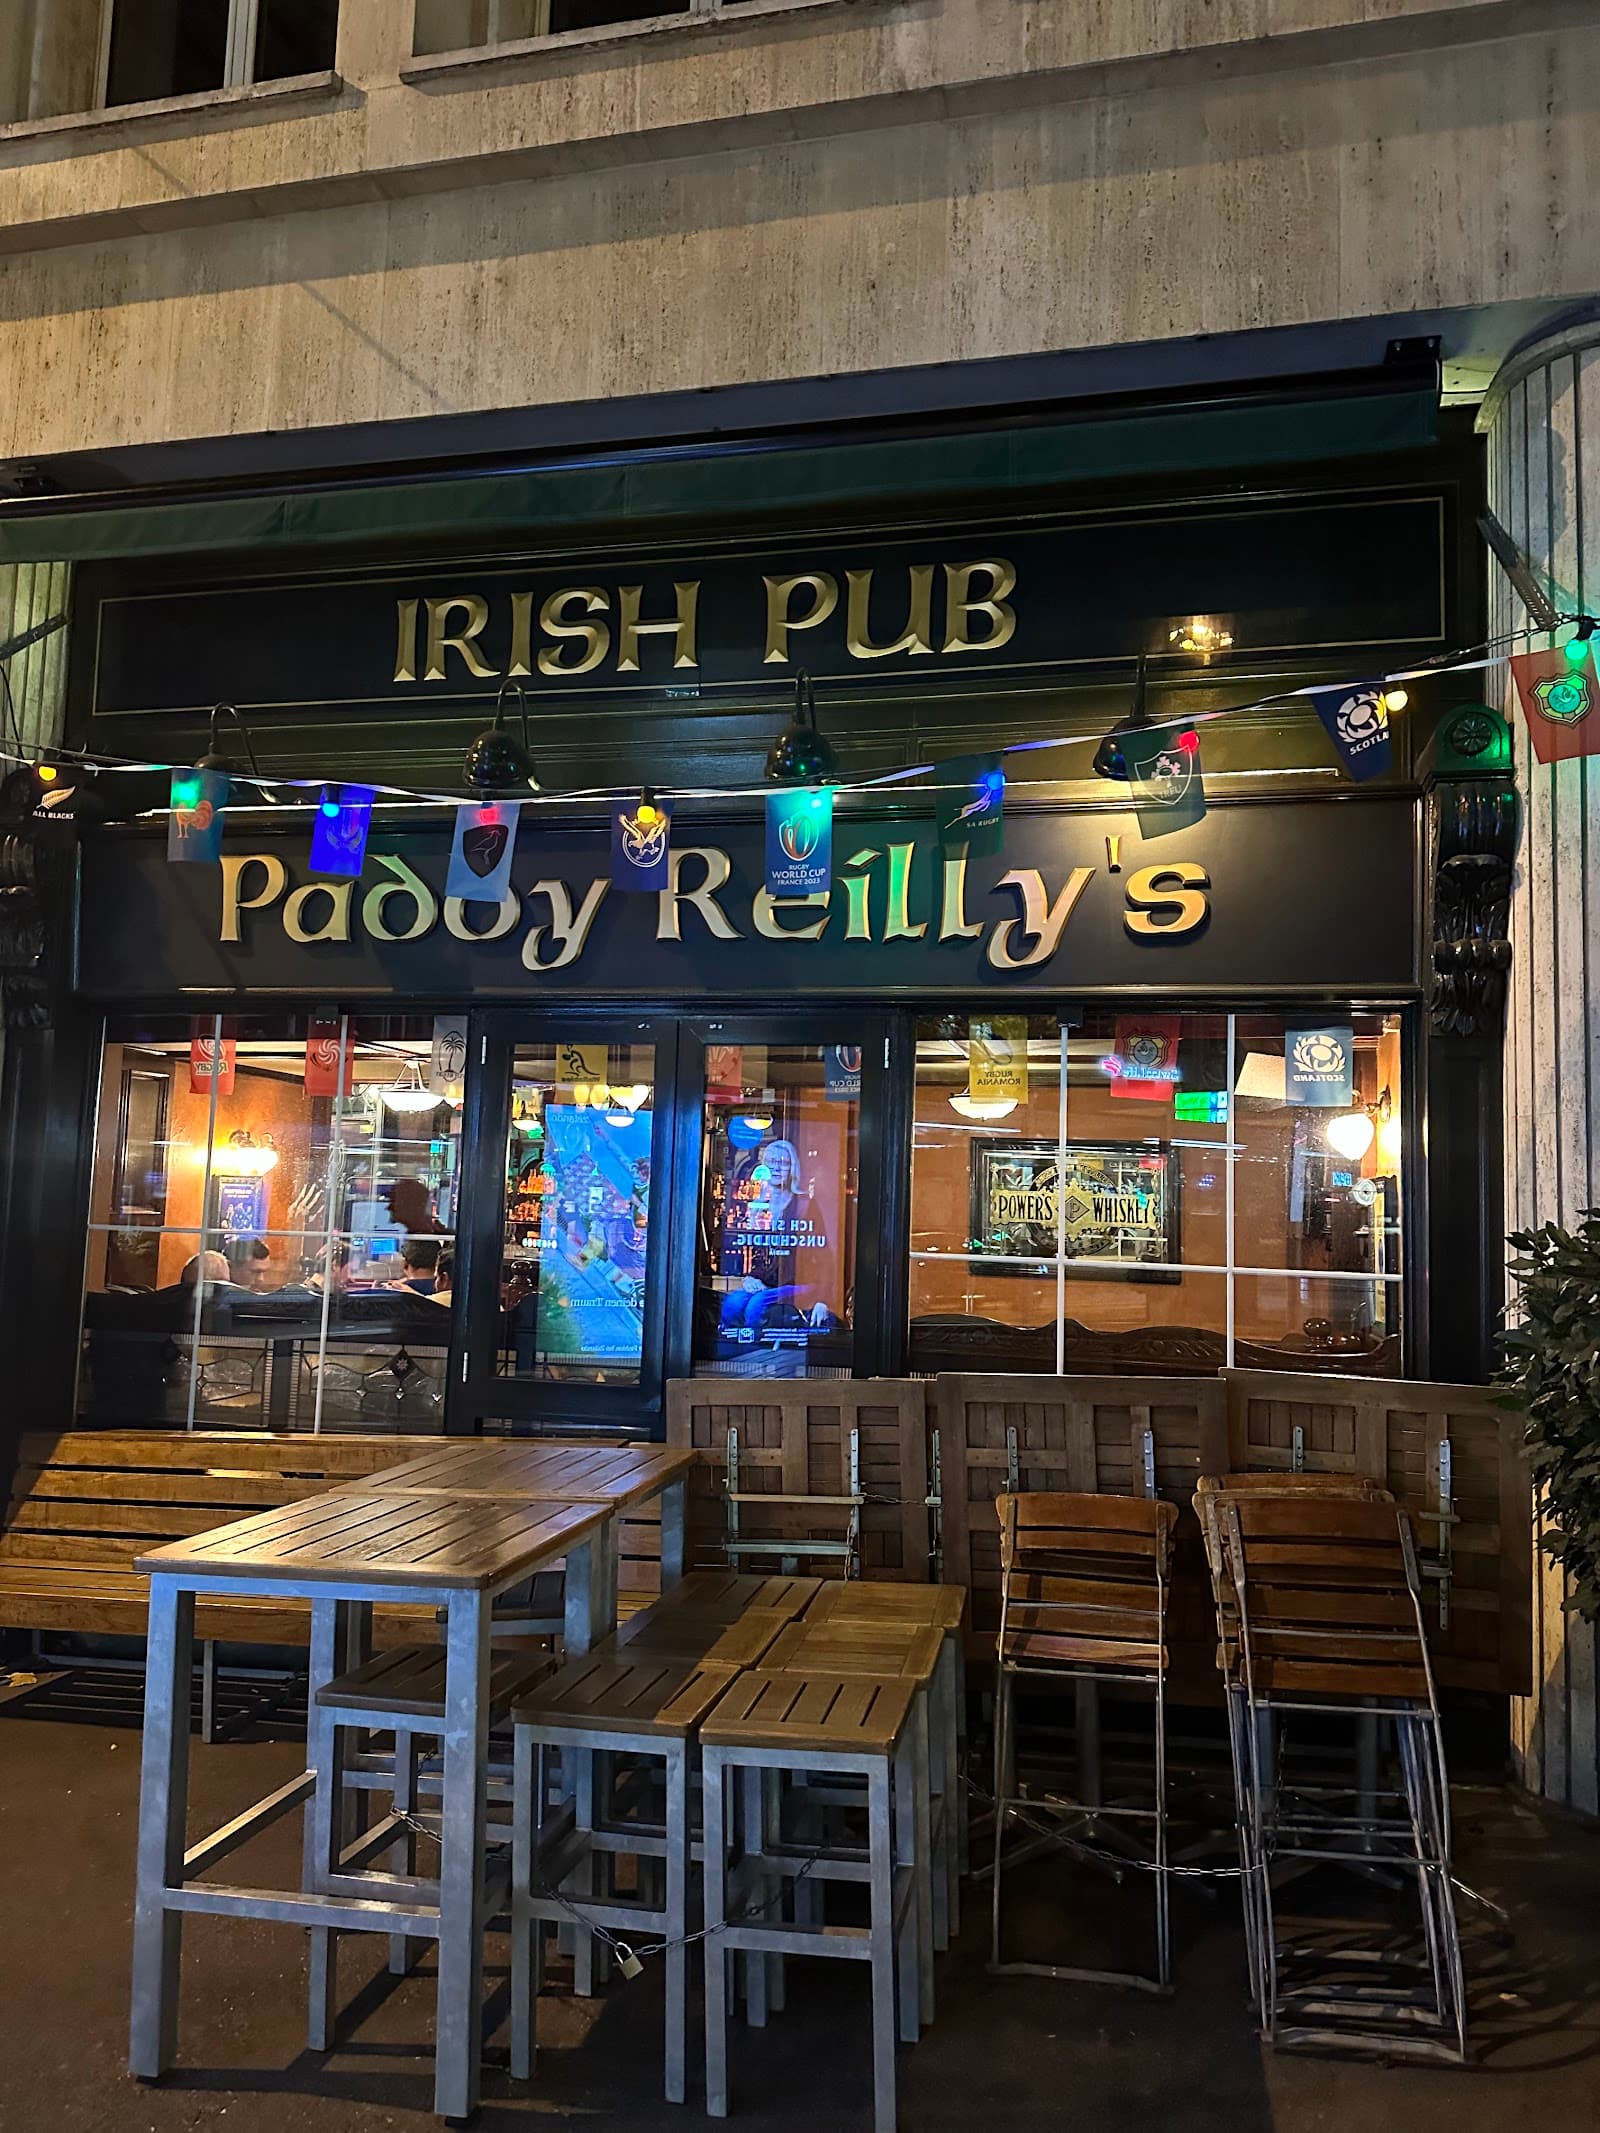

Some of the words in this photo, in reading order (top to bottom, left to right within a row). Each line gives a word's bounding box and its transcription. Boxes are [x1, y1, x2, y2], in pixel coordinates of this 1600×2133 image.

[393, 580, 701, 682] IRISH
[761, 557, 1017, 665] PUB
[32, 810, 46, 818] ALL
[978, 817, 999, 827] RUGBY
[771, 870, 807, 879] WORLD
[808, 868, 826, 877] CUP
[655, 835, 1212, 970] Reilly's
[1093, 1196, 1150, 1223] WHISKEY
